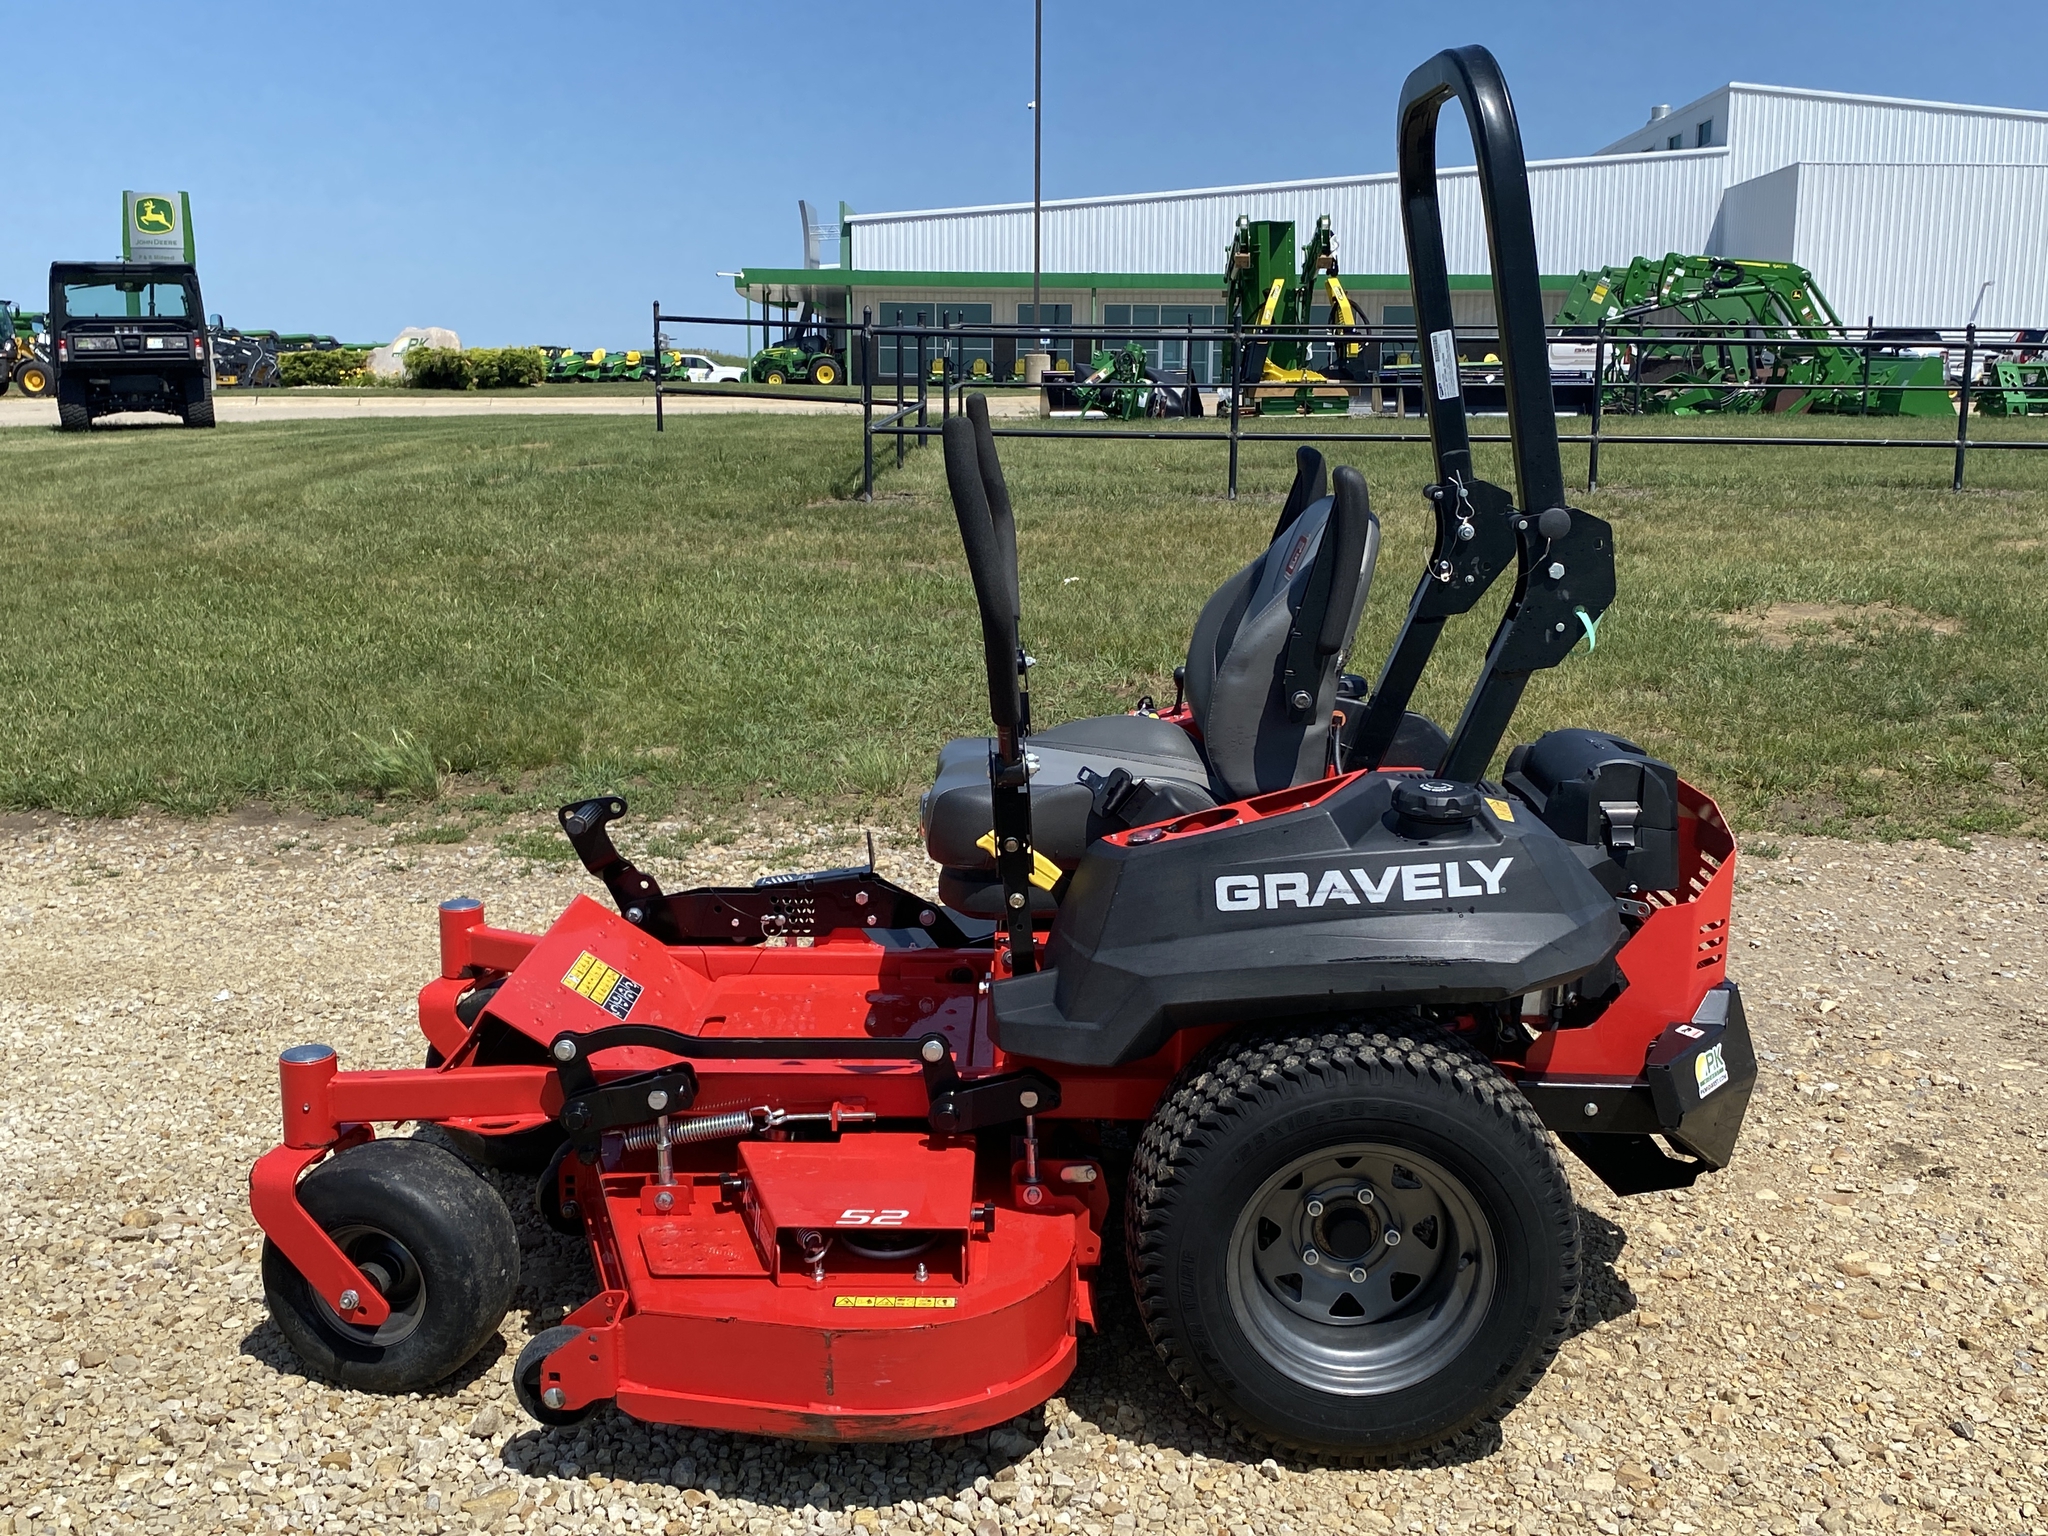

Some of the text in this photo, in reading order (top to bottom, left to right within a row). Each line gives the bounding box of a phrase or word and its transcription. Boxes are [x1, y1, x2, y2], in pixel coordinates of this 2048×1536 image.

[1215, 857, 1515, 912] GRAVELY
[1705, 1046, 1724, 1075] PK
[835, 1209, 910, 1225] 52
[1180, 1250, 1198, 1314] TURF
